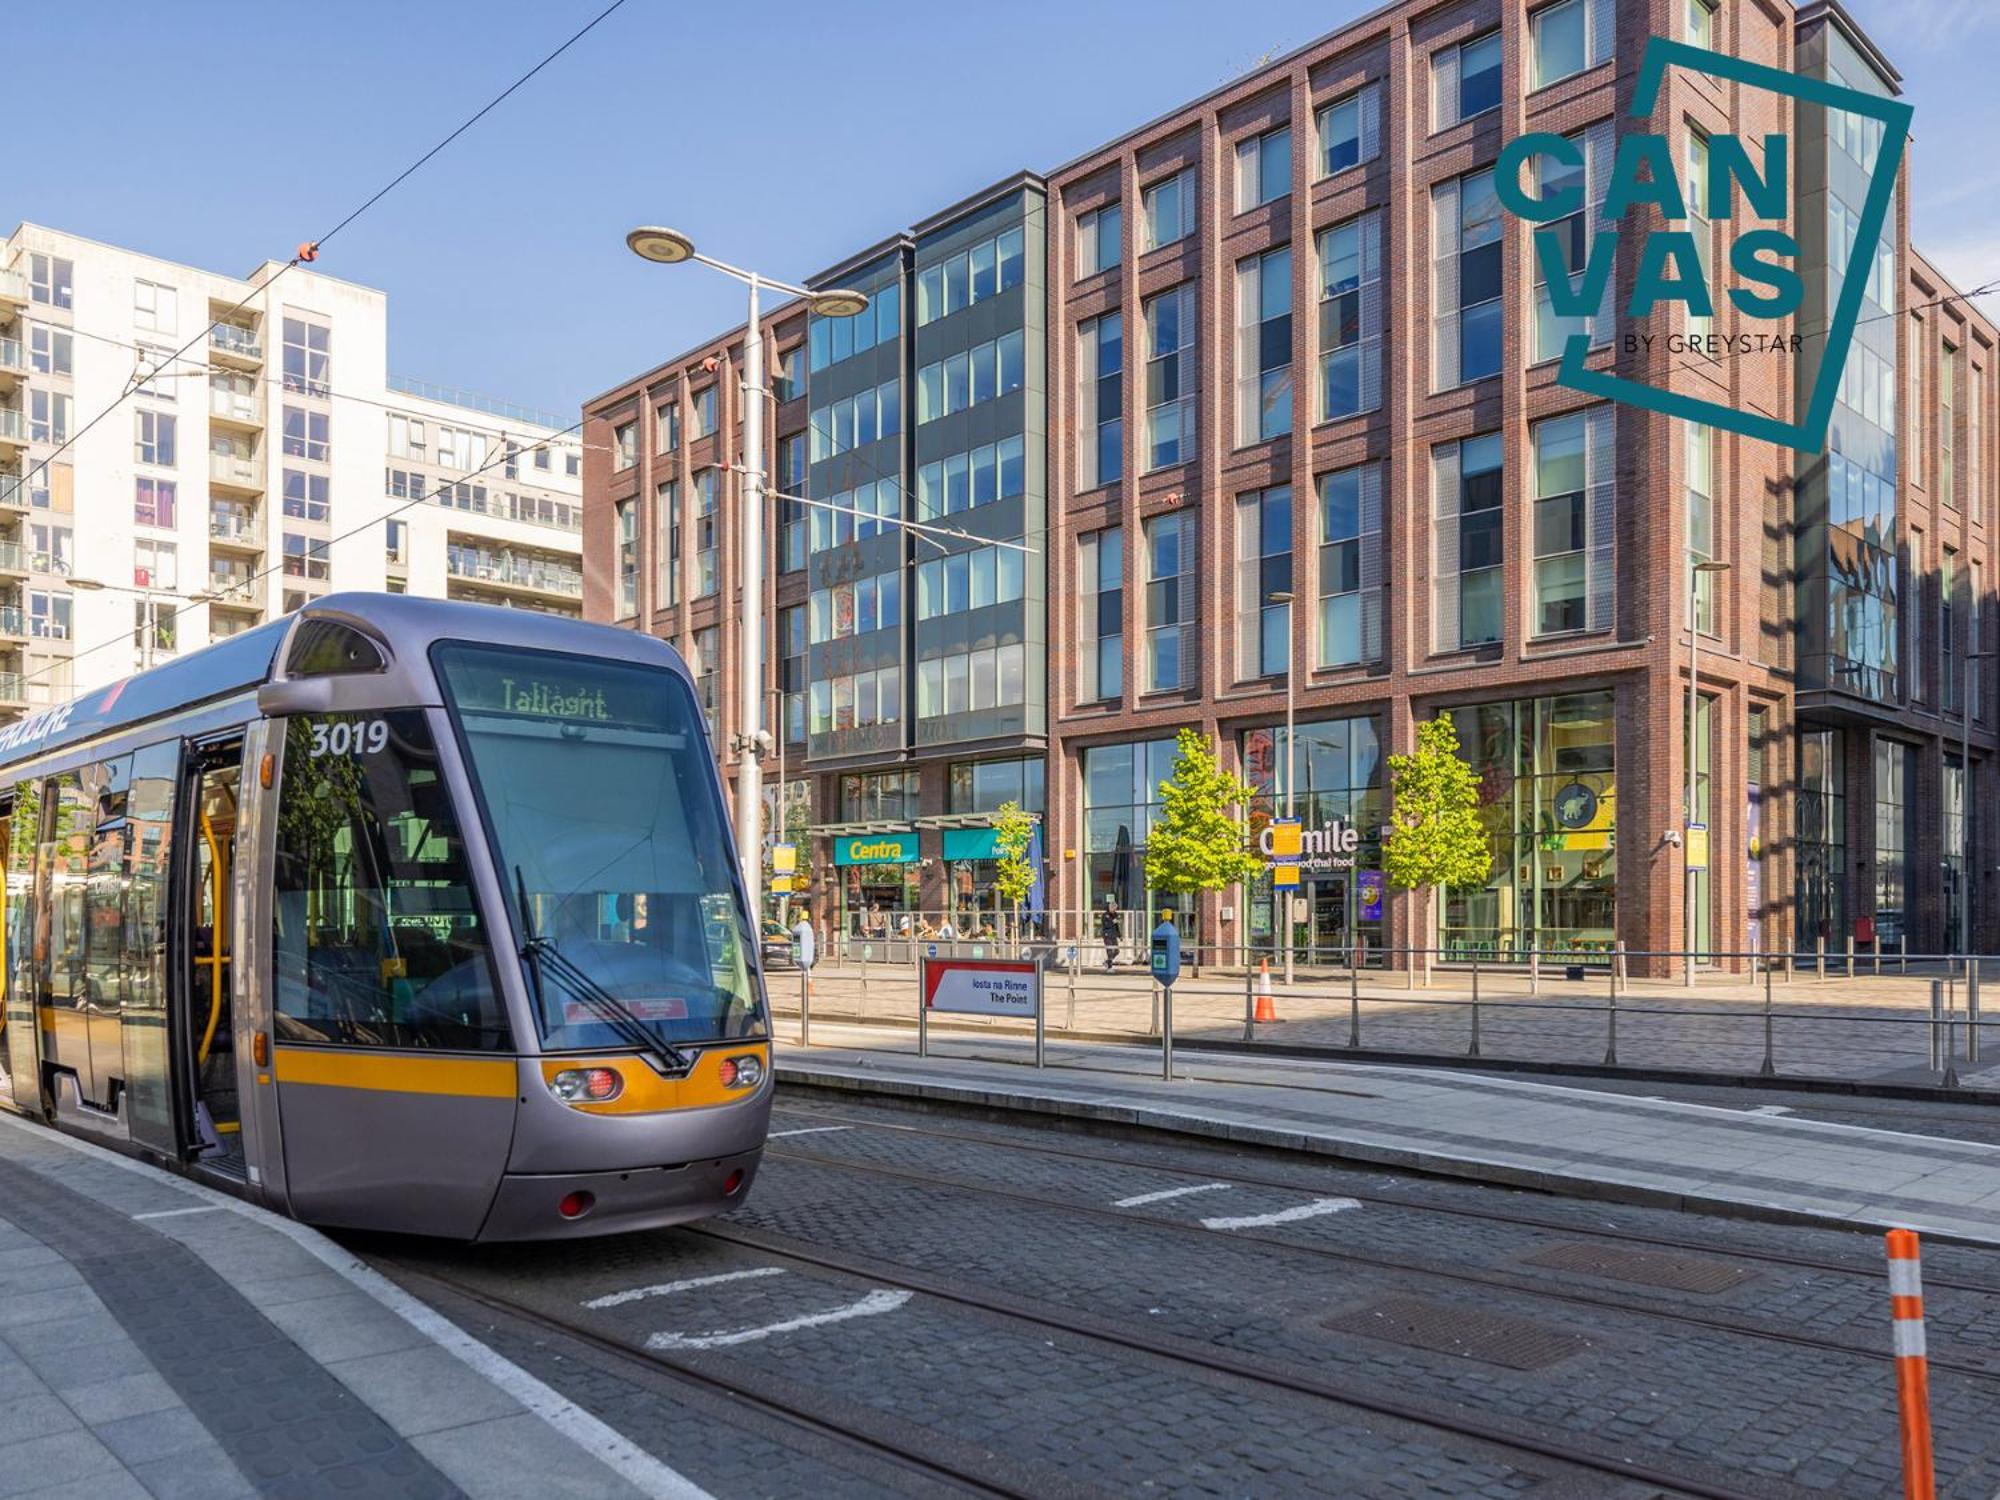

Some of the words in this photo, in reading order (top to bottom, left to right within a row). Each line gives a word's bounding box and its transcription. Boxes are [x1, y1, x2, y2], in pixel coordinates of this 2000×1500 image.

[309, 719, 389, 758] 3019
[1260, 821, 1359, 855] Cmile
[849, 840, 902, 860] Centra
[1333, 856, 1355, 867] food
[993, 982, 1003, 990] na
[1004, 980, 1028, 991] Rinne
[990, 992, 1005, 1003] The
[1006, 993, 1027, 1004] Point
